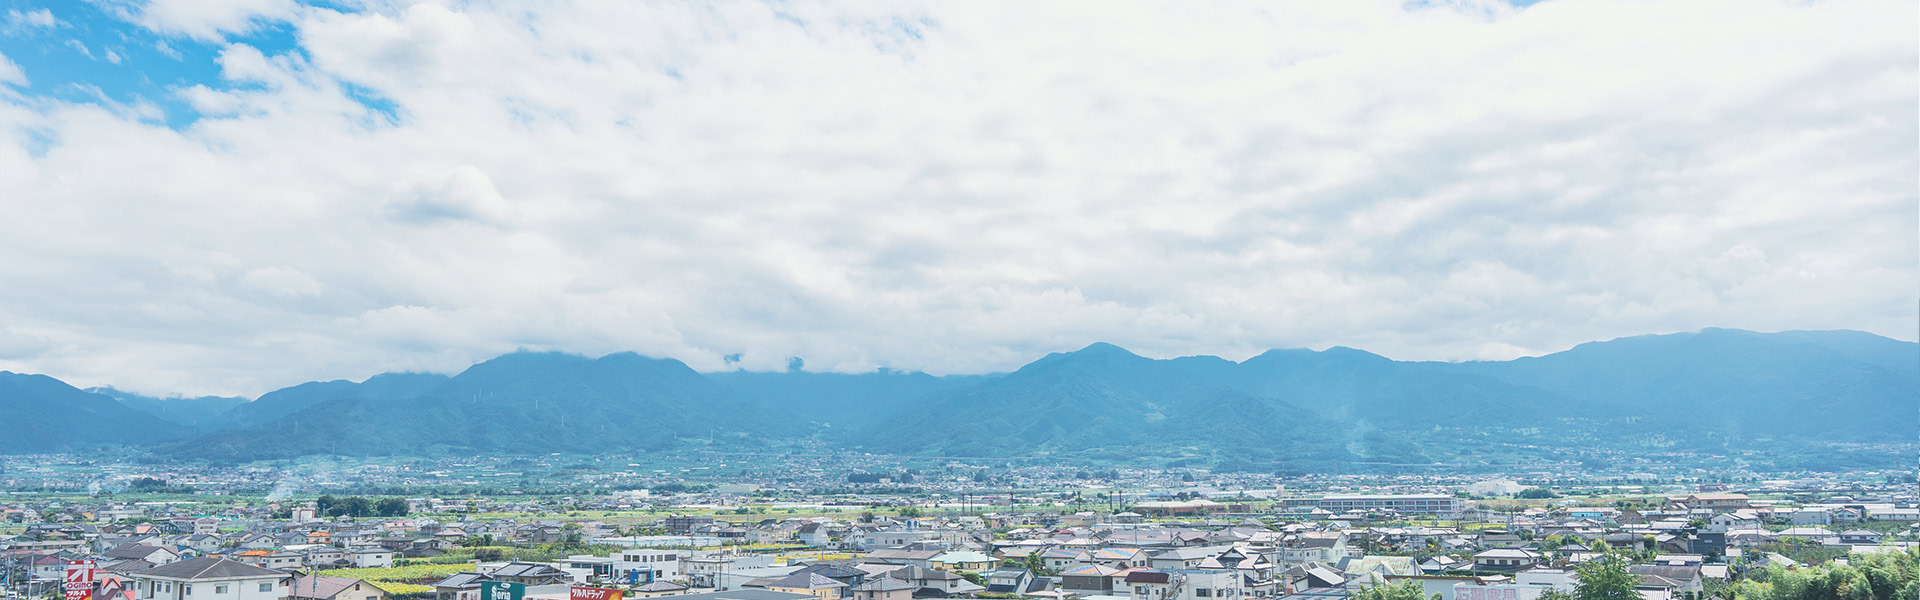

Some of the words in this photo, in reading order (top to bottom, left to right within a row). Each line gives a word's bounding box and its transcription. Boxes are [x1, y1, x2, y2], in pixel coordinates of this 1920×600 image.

[491, 584, 511, 600] Seria
[571, 588, 606, 599] ツルハドラッグ
